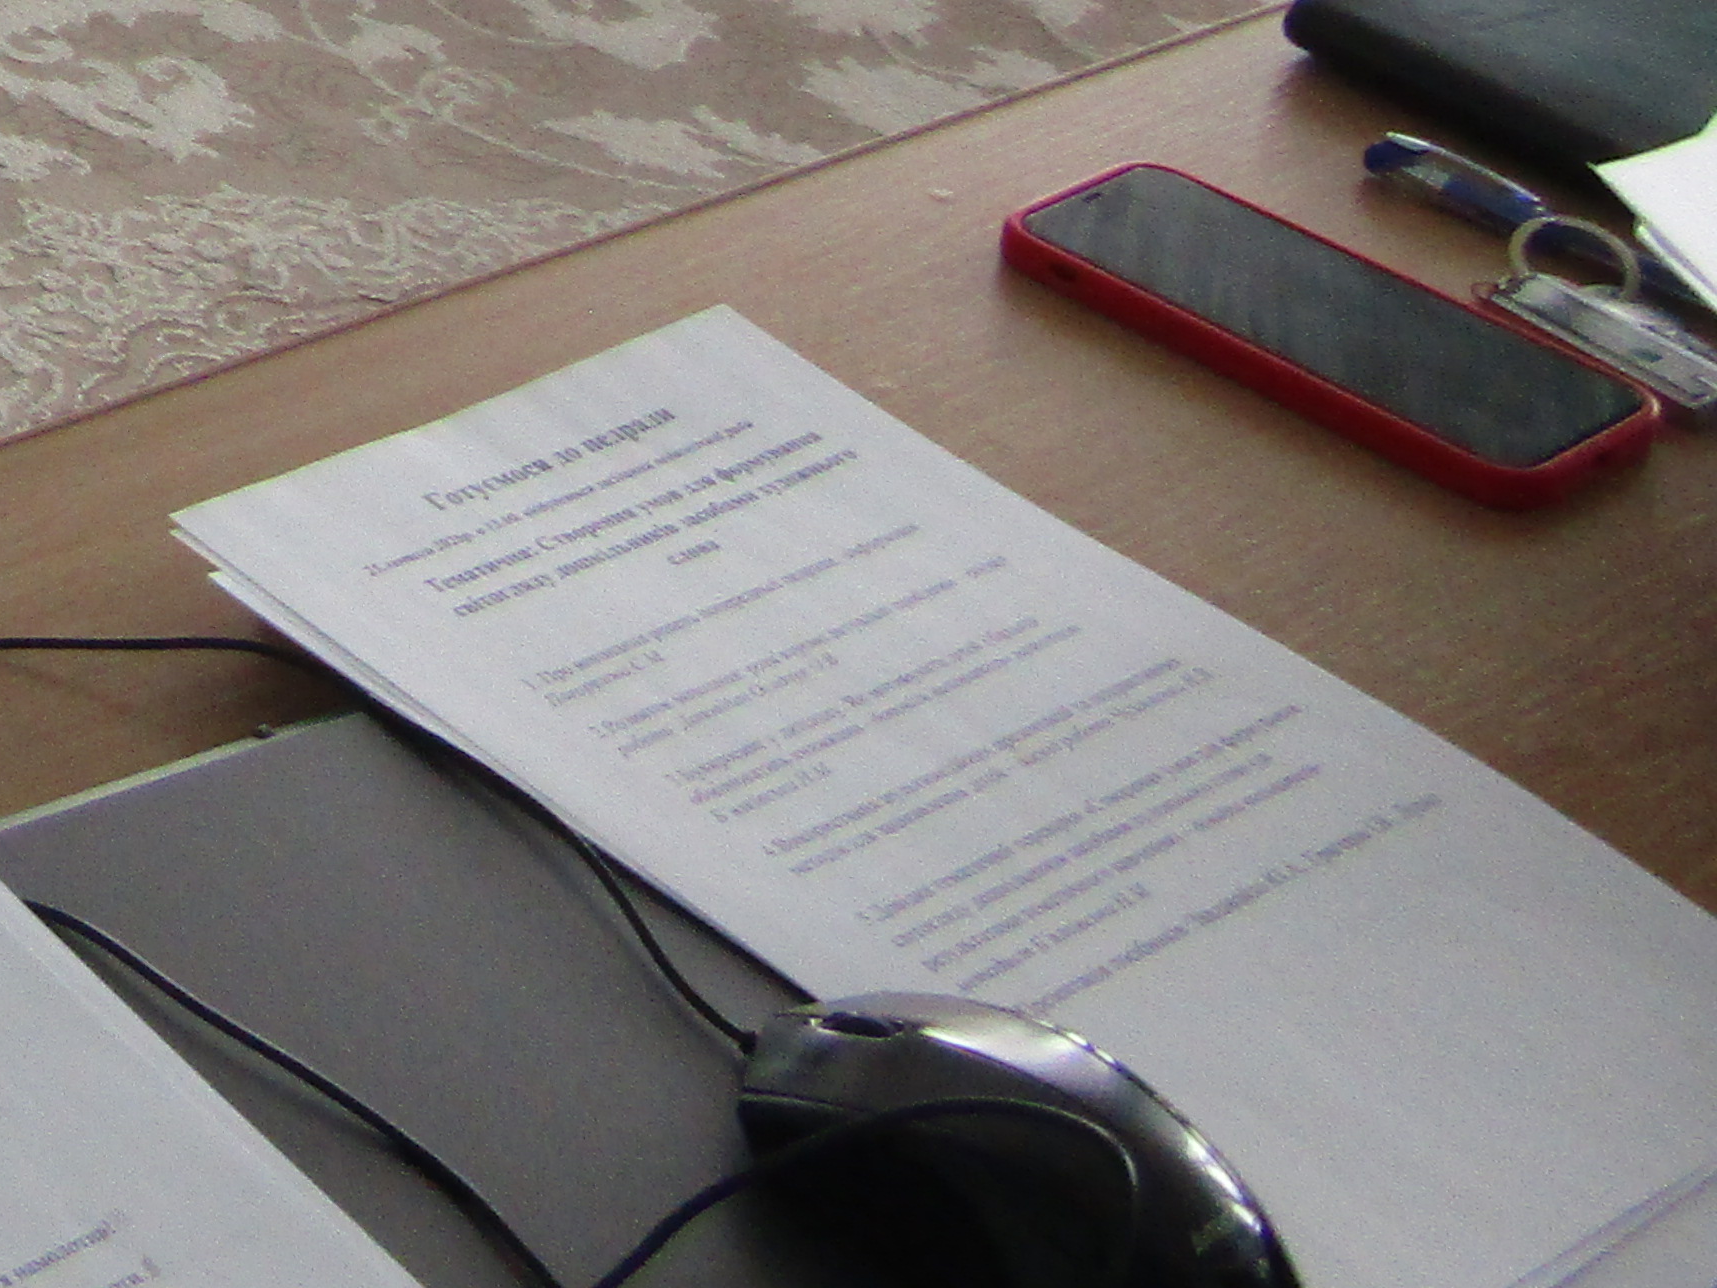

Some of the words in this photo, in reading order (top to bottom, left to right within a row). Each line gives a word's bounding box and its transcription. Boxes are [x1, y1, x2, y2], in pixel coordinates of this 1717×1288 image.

[421, 458, 555, 512] Готуємося
[552, 446, 584, 468] до
[534, 507, 639, 552] Створення
[635, 489, 685, 517] умов
[683, 475, 718, 496] для
[712, 430, 824, 483] формування
[665, 539, 723, 568] слова
